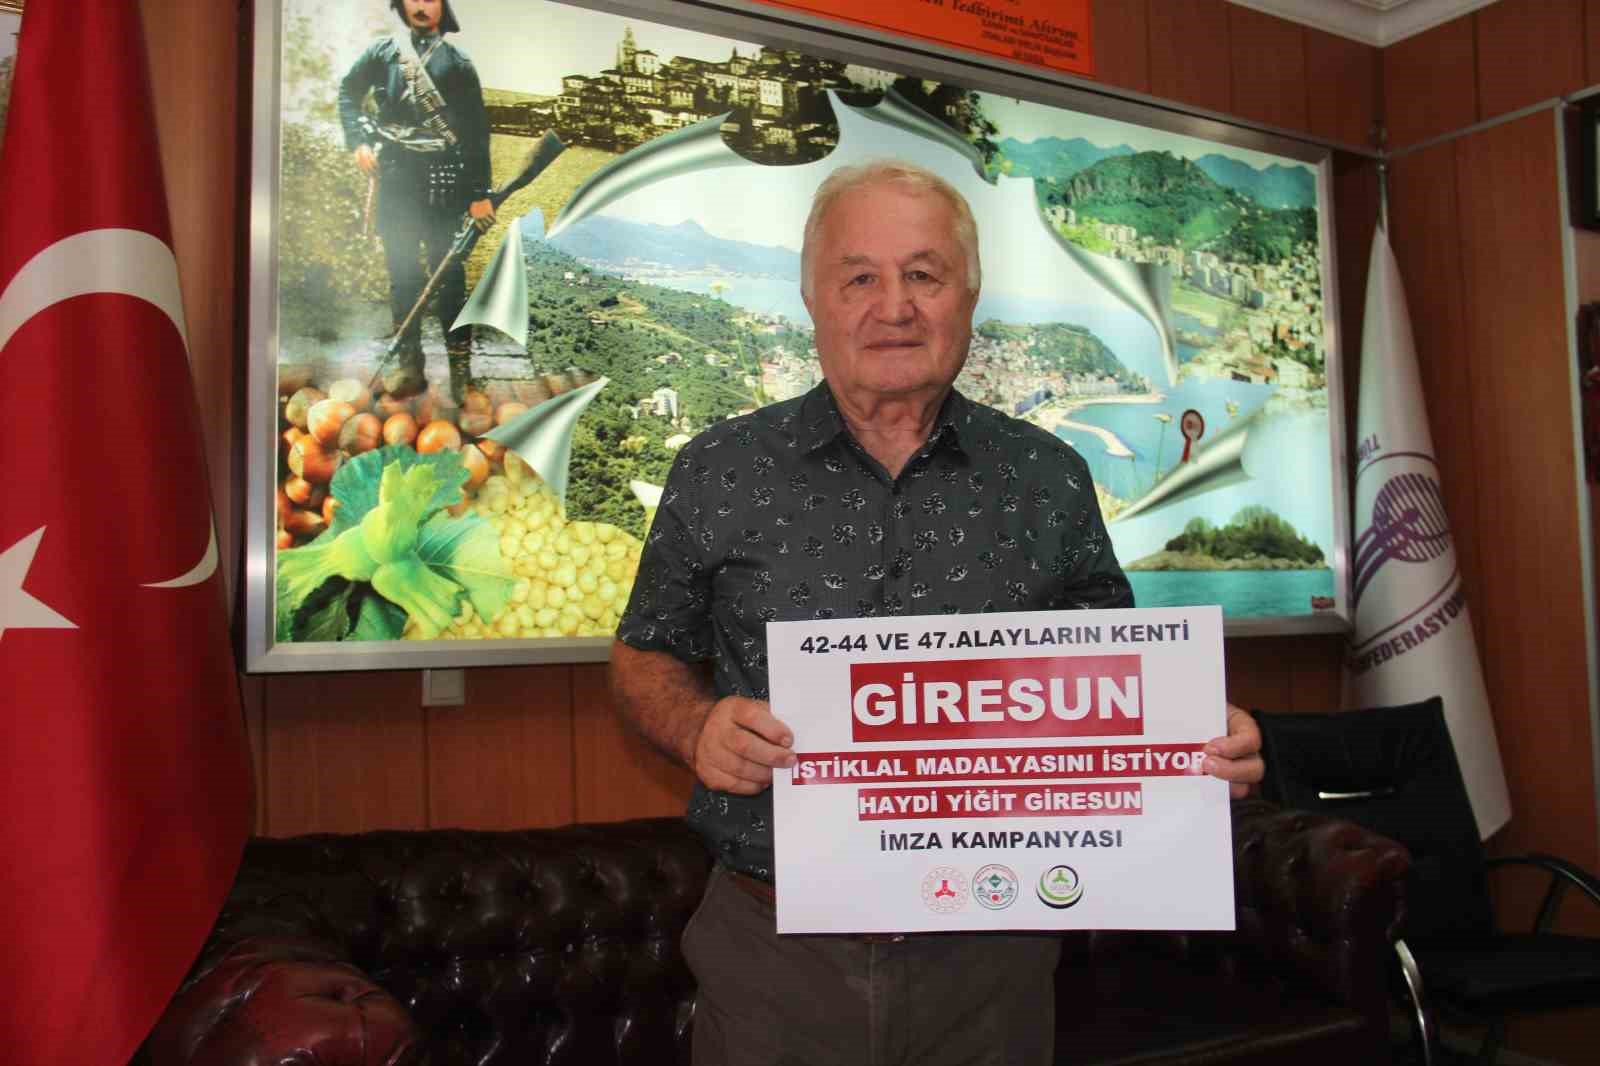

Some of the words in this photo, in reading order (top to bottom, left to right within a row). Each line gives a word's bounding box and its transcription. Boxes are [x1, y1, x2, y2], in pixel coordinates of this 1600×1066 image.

[800, 634, 868, 654] 42-44
[876, 632, 910, 651] VE
[918, 626, 1101, 649] 47.ALAYLARIN
[1111, 618, 1190, 643] KENTİ
[852, 672, 1141, 726] GİRESUN
[915, 750, 1094, 776] MADALYASINI
[859, 789, 938, 815] HAYDİ
[946, 786, 1015, 812] YİĞİT
[1024, 785, 1142, 811] GİRESUN
[880, 829, 942, 852] İMZA
[951, 829, 1122, 849] KAMPANYASI
